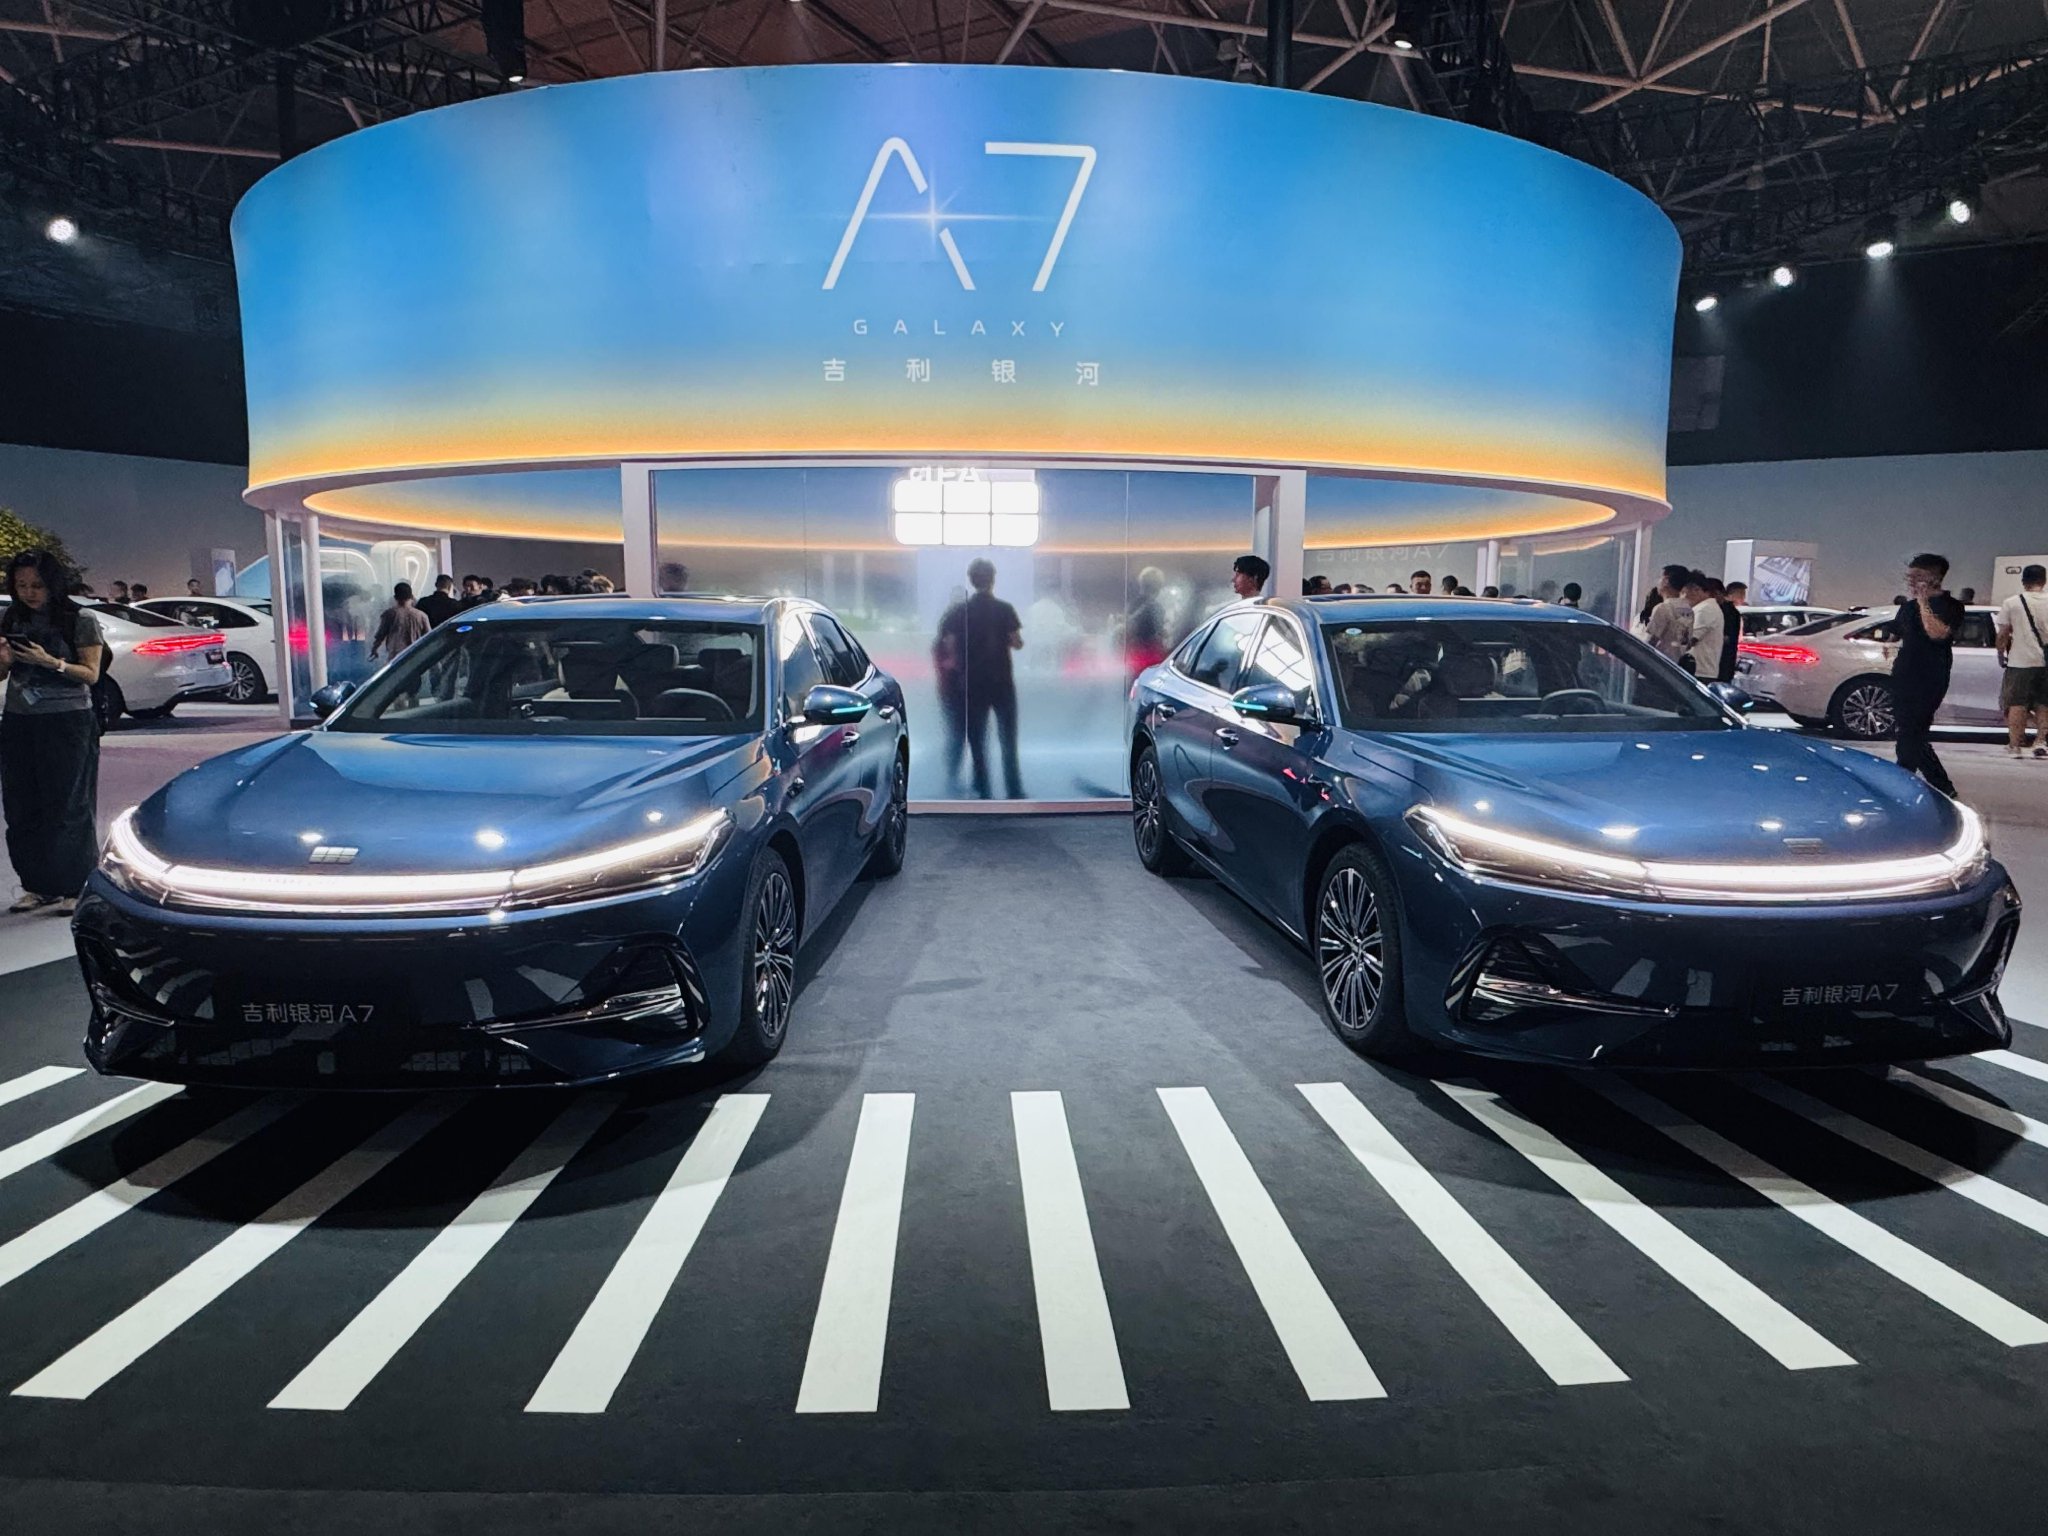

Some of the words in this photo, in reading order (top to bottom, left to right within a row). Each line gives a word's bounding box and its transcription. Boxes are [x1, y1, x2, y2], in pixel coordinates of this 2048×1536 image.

[821, 136, 1097, 292] A7
[853, 319, 1065, 337] GALAXY
[822, 358, 1100, 386] 吉利银河
[1782, 983, 1899, 1006] 吉利银河A7
[241, 1002, 375, 1023] 吉利银河A7
